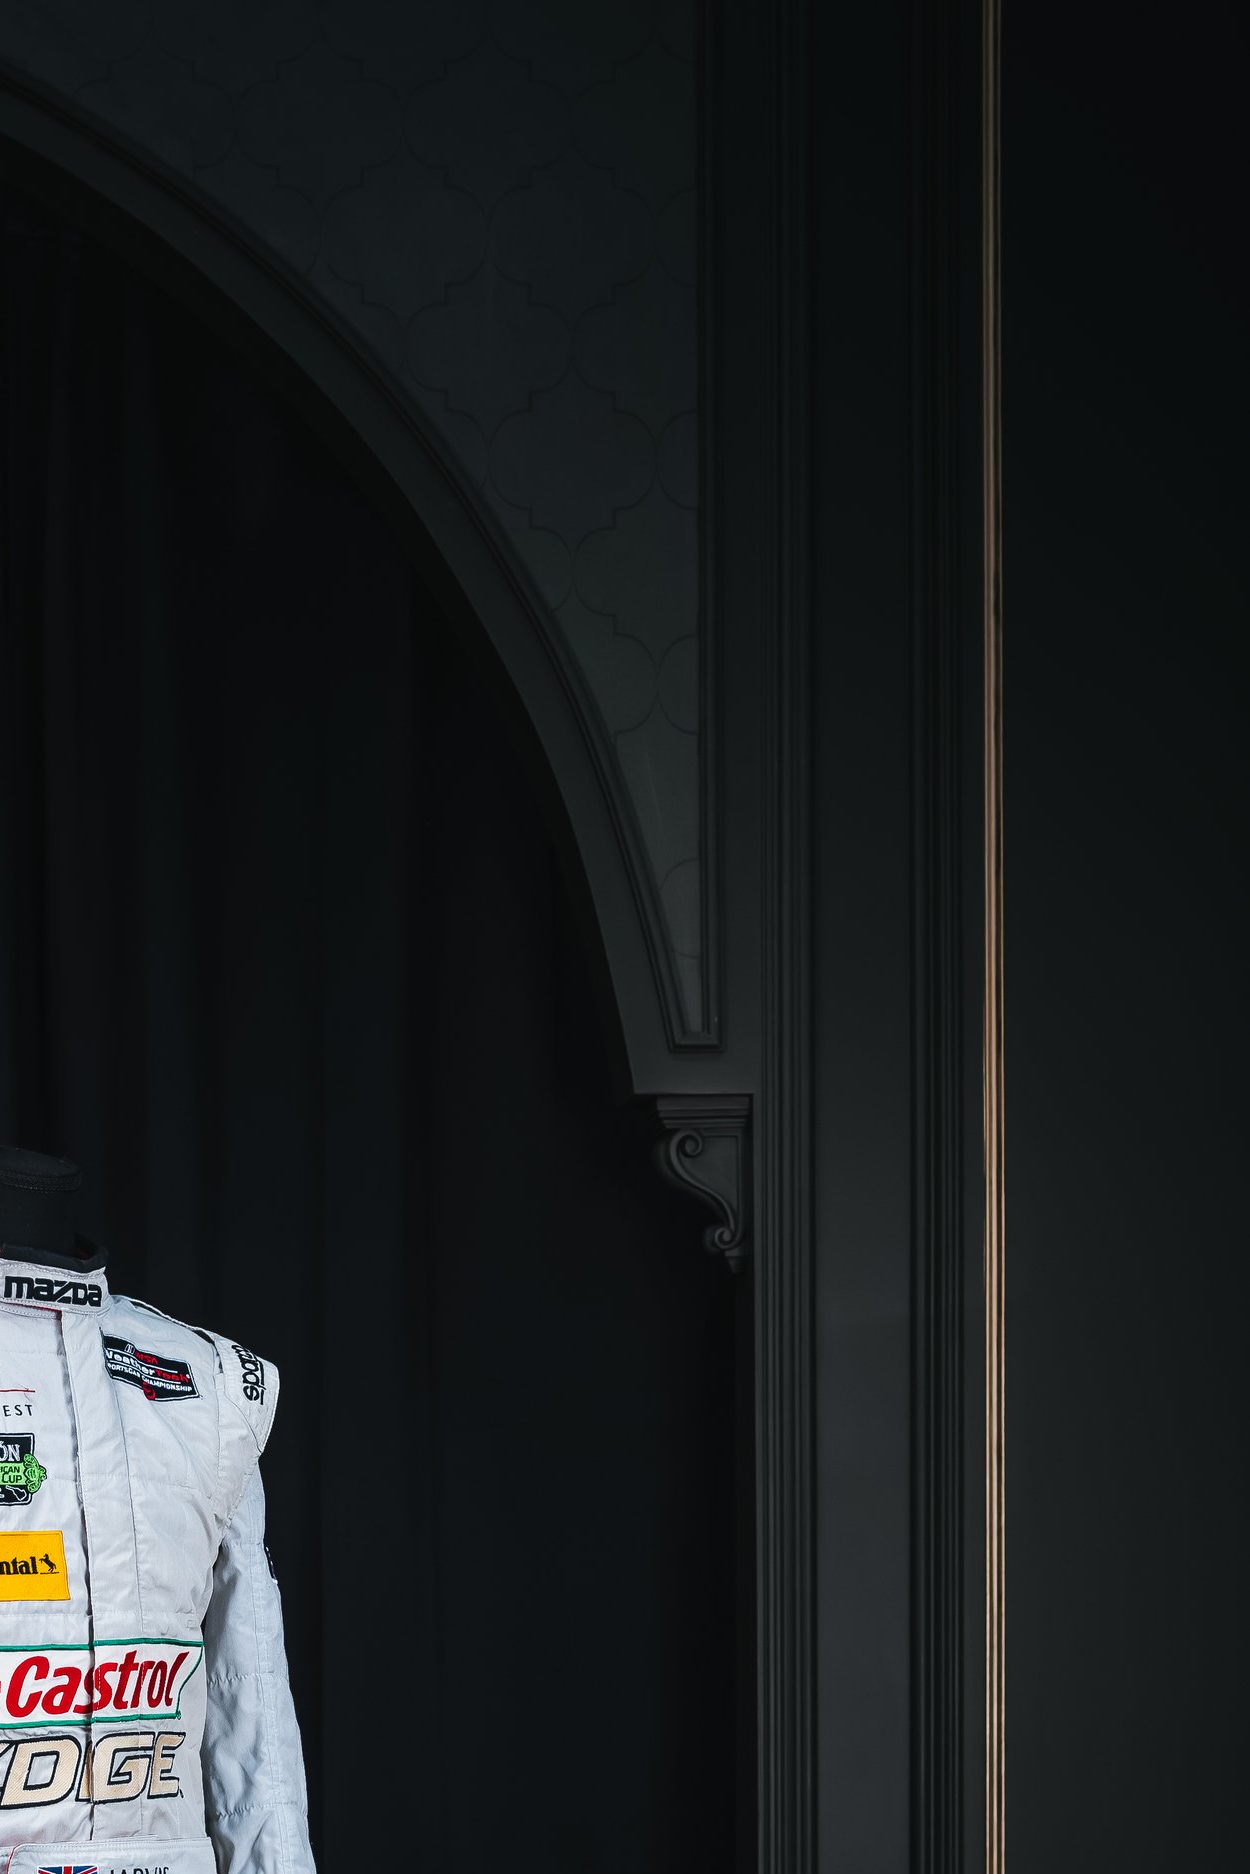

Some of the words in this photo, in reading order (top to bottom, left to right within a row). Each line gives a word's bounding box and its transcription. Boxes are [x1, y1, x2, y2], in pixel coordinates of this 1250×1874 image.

[4, 1275, 102, 1307] mazda
[141, 1374, 193, 1392] CHAMPIONSHIP
[1, 1471, 23, 1484] CUP
[5, 1650, 190, 1718] Castrol
